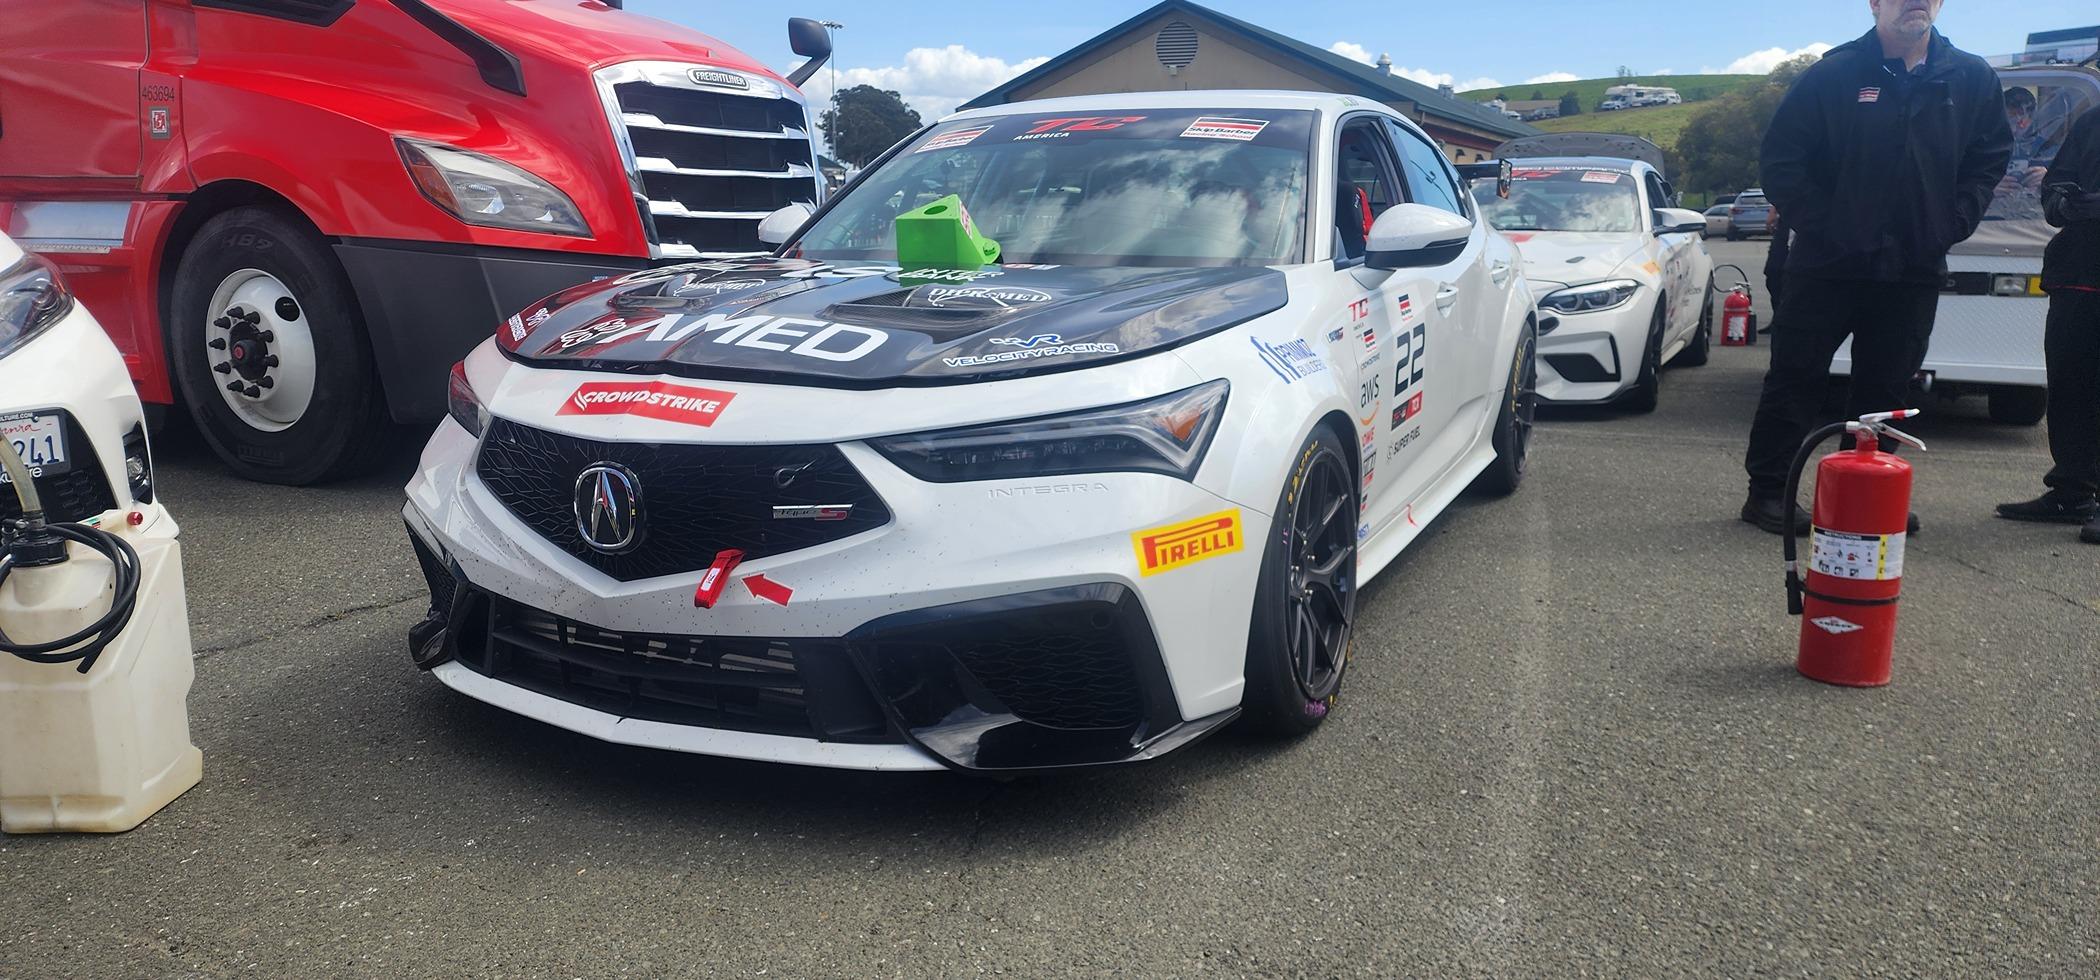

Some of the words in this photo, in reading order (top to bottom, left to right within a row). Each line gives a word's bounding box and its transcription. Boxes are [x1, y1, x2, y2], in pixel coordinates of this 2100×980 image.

[695, 71, 746, 86] FREIGHTLINER
[142, 85, 175, 101] 463694
[1013, 132, 1070, 141] AMERICA
[943, 348, 1045, 367] VELOCITY
[1044, 342, 1119, 356] RACING
[1394, 322, 1425, 397] 22
[584, 390, 721, 413] CROWDSTRIKE
[1361, 373, 1380, 408] aws
[988, 483, 1109, 499] INTEGRA
[1141, 517, 1234, 569] PIRELLI
